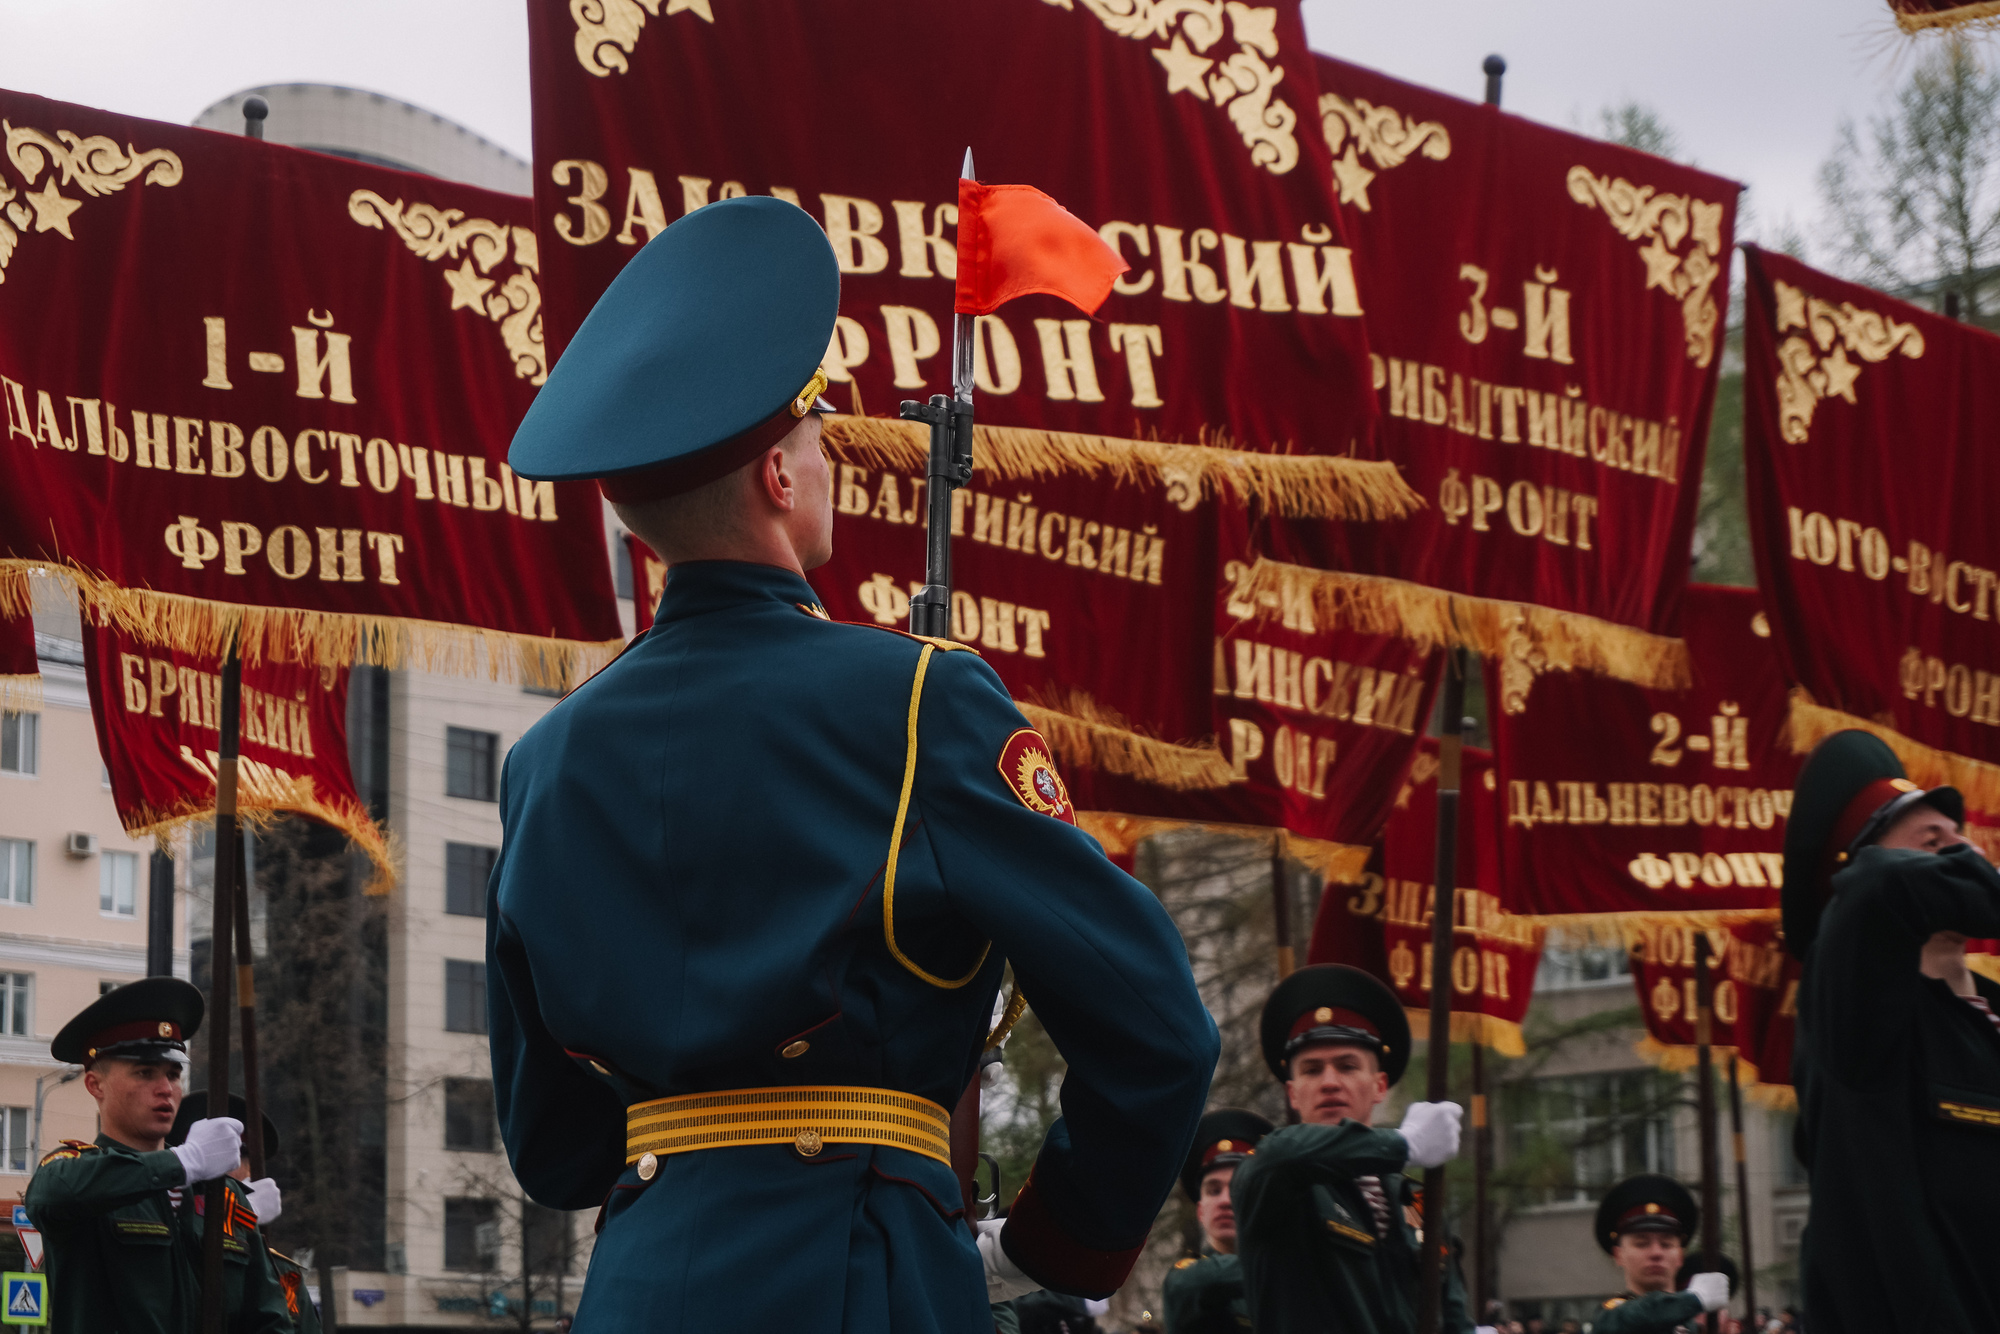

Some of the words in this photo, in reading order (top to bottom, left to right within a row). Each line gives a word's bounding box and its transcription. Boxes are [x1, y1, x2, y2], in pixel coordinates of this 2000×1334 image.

[552, 159, 1364, 316] ЗАВКСКИЙ
[203, 308, 357, 403] 1-Й
[1459, 262, 1574, 364] 3-Й
[165, 515, 404, 585] ФРОНТ
[1439, 468, 1598, 550] ФРОНТ
[1788, 505, 2000, 624] ЮГО-ВСТ
[858, 572, 1050, 658] ФОНТ
[120, 651, 316, 759] БРЯНКИЙ
[1650, 701, 1750, 769] 2-Й
[1627, 852, 1784, 889] ФРОНТ
